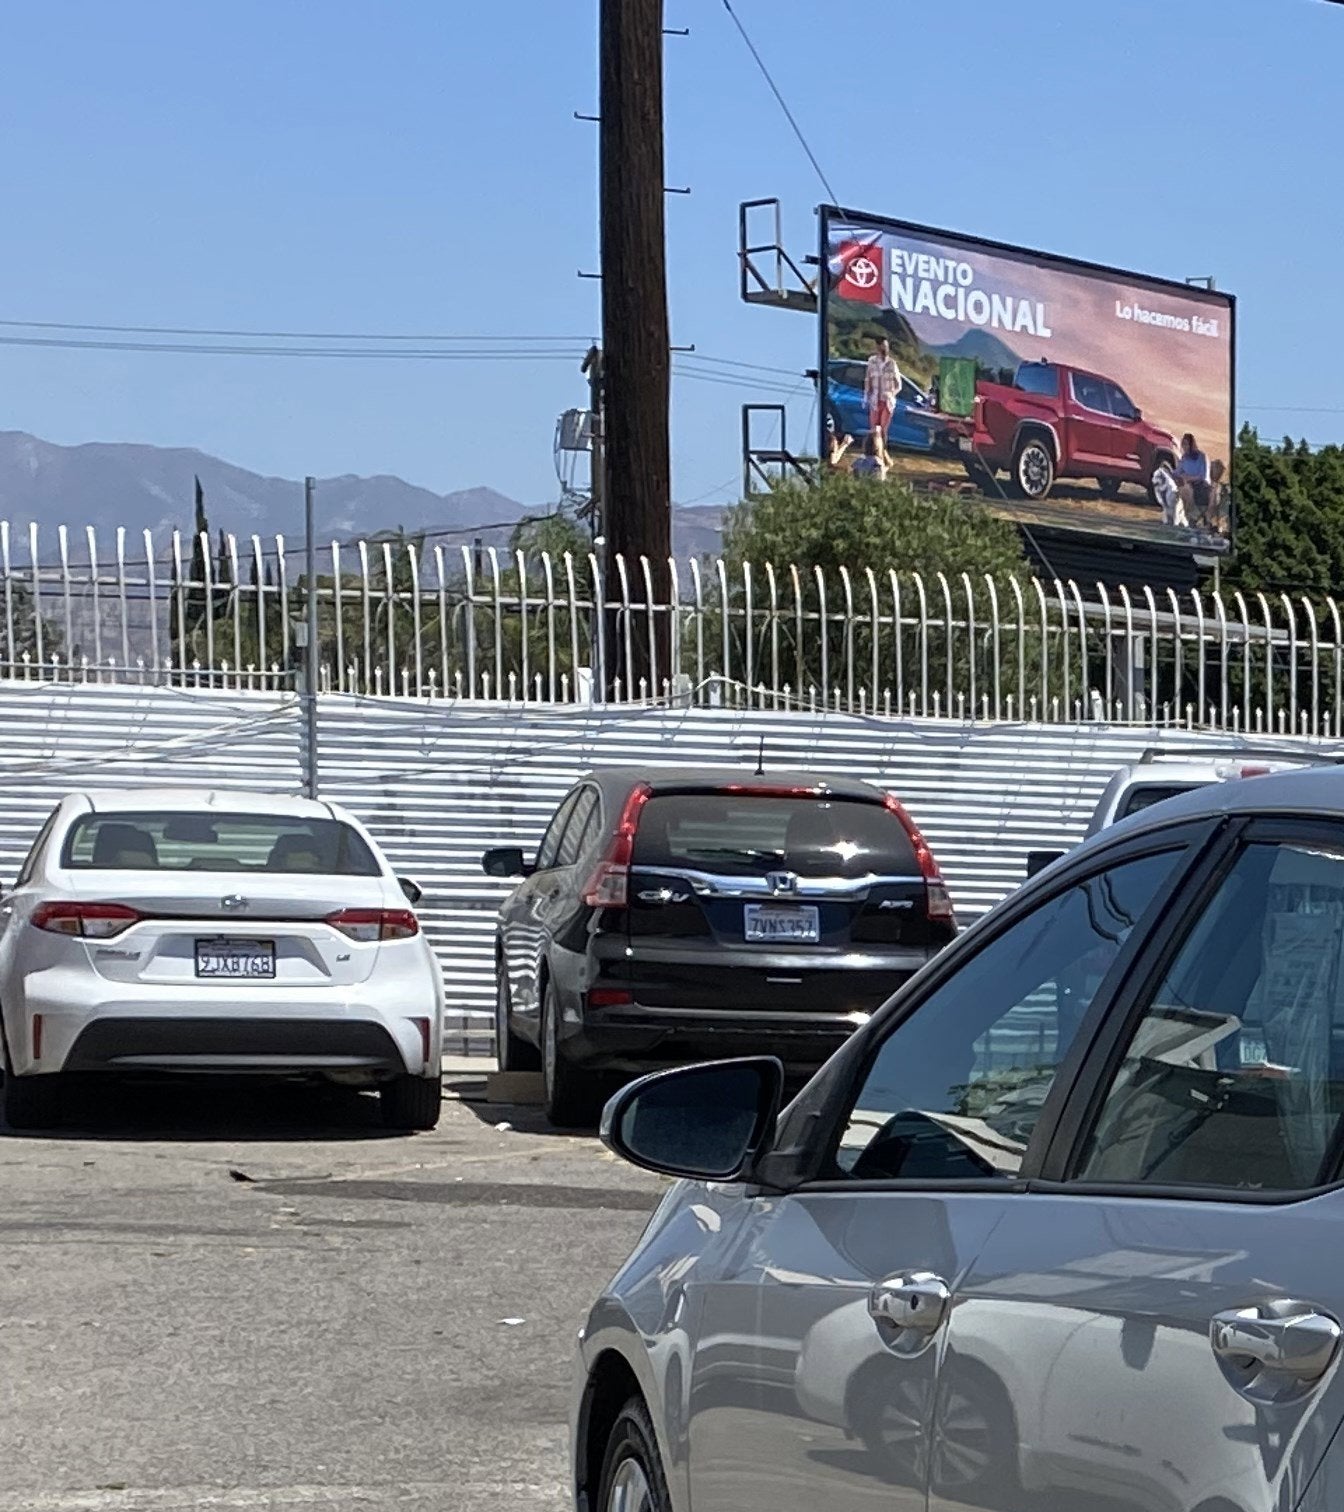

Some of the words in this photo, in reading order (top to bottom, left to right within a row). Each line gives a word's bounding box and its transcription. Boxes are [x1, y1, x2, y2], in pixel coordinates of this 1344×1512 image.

[891, 248, 973, 286] EVENTO
[891, 276, 1052, 338] NACIONAL
[1115, 300, 1131, 319] Lo
[1133, 303, 1190, 331] hacemos
